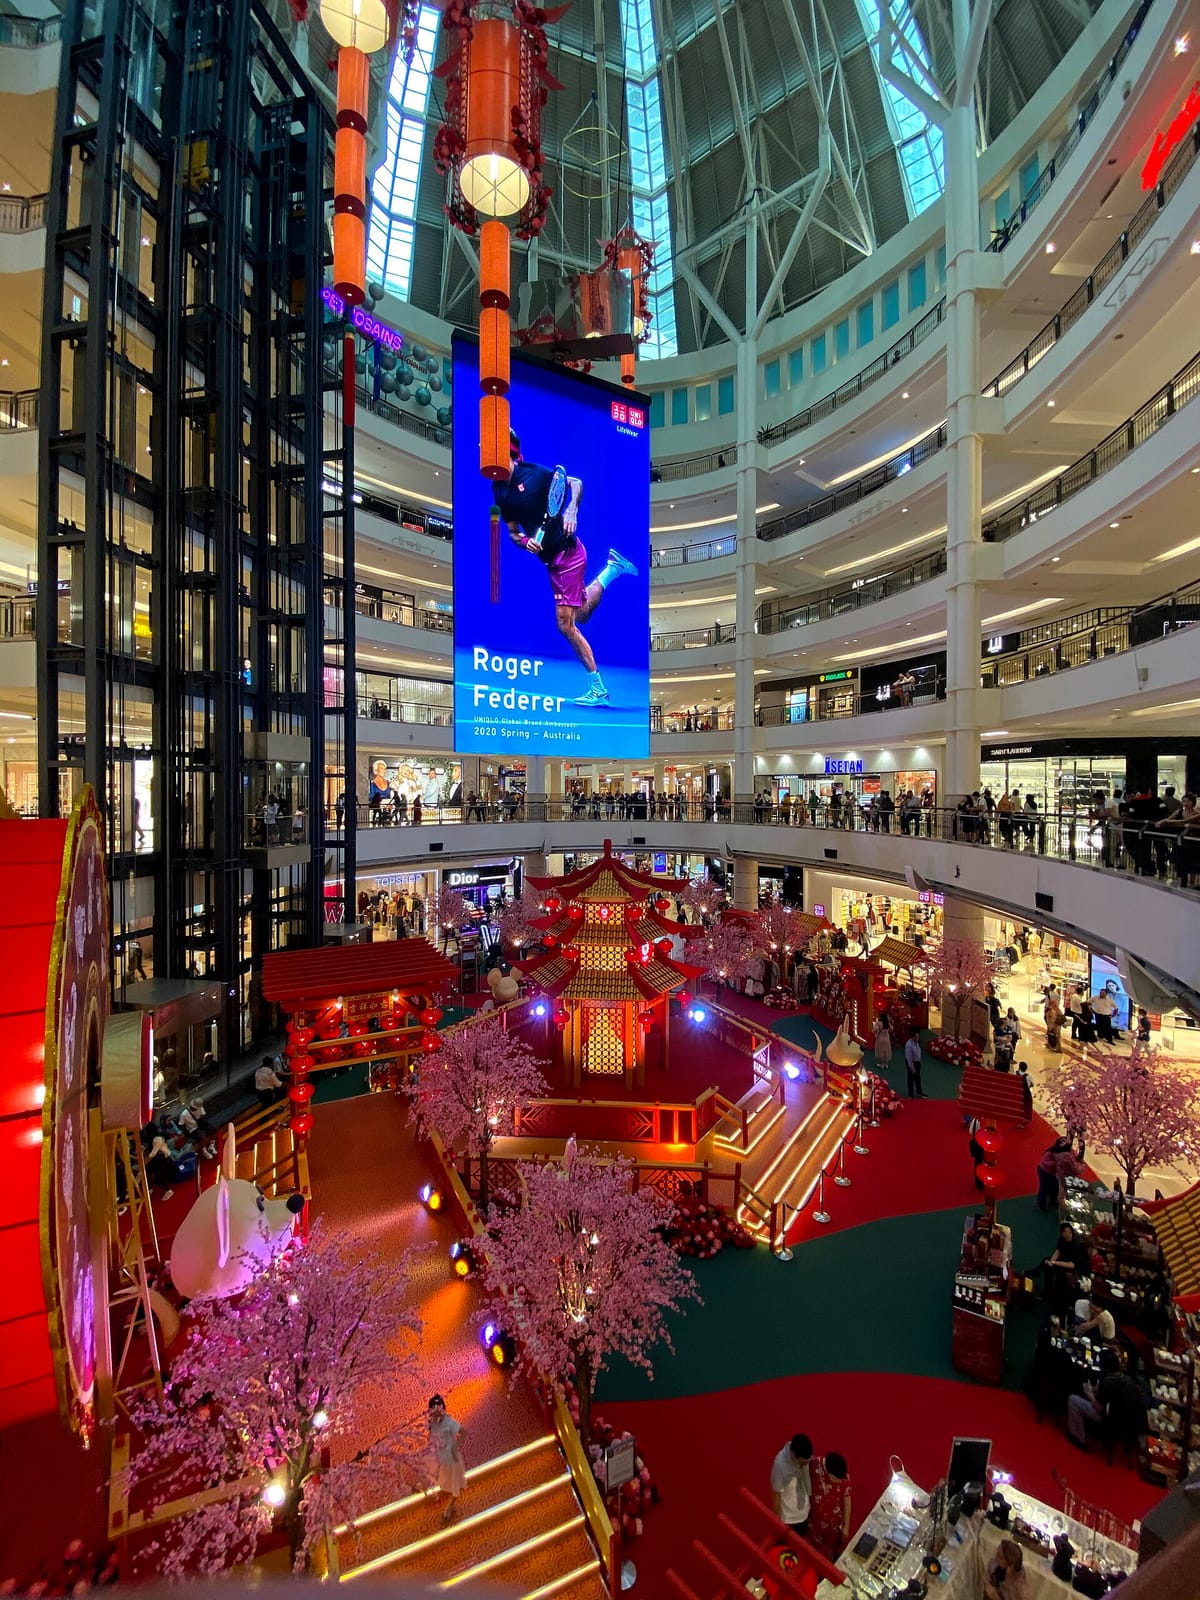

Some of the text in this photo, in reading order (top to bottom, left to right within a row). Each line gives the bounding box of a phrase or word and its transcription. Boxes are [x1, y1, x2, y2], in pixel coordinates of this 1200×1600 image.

[322, 288, 403, 350] PETOSAINS
[473, 647, 544, 680] Roger
[473, 684, 566, 713] Federer
[473, 715, 499, 724] UNIQLO
[501, 717, 521, 725] Global
[474, 726, 497, 737] 2020
[501, 727, 530, 740] Spring
[543, 730, 581, 741] Australia
[824, 757, 863, 774] ISETAN
[375, 873, 423, 888] TOPSHOP
[450, 873, 480, 886] Dior
